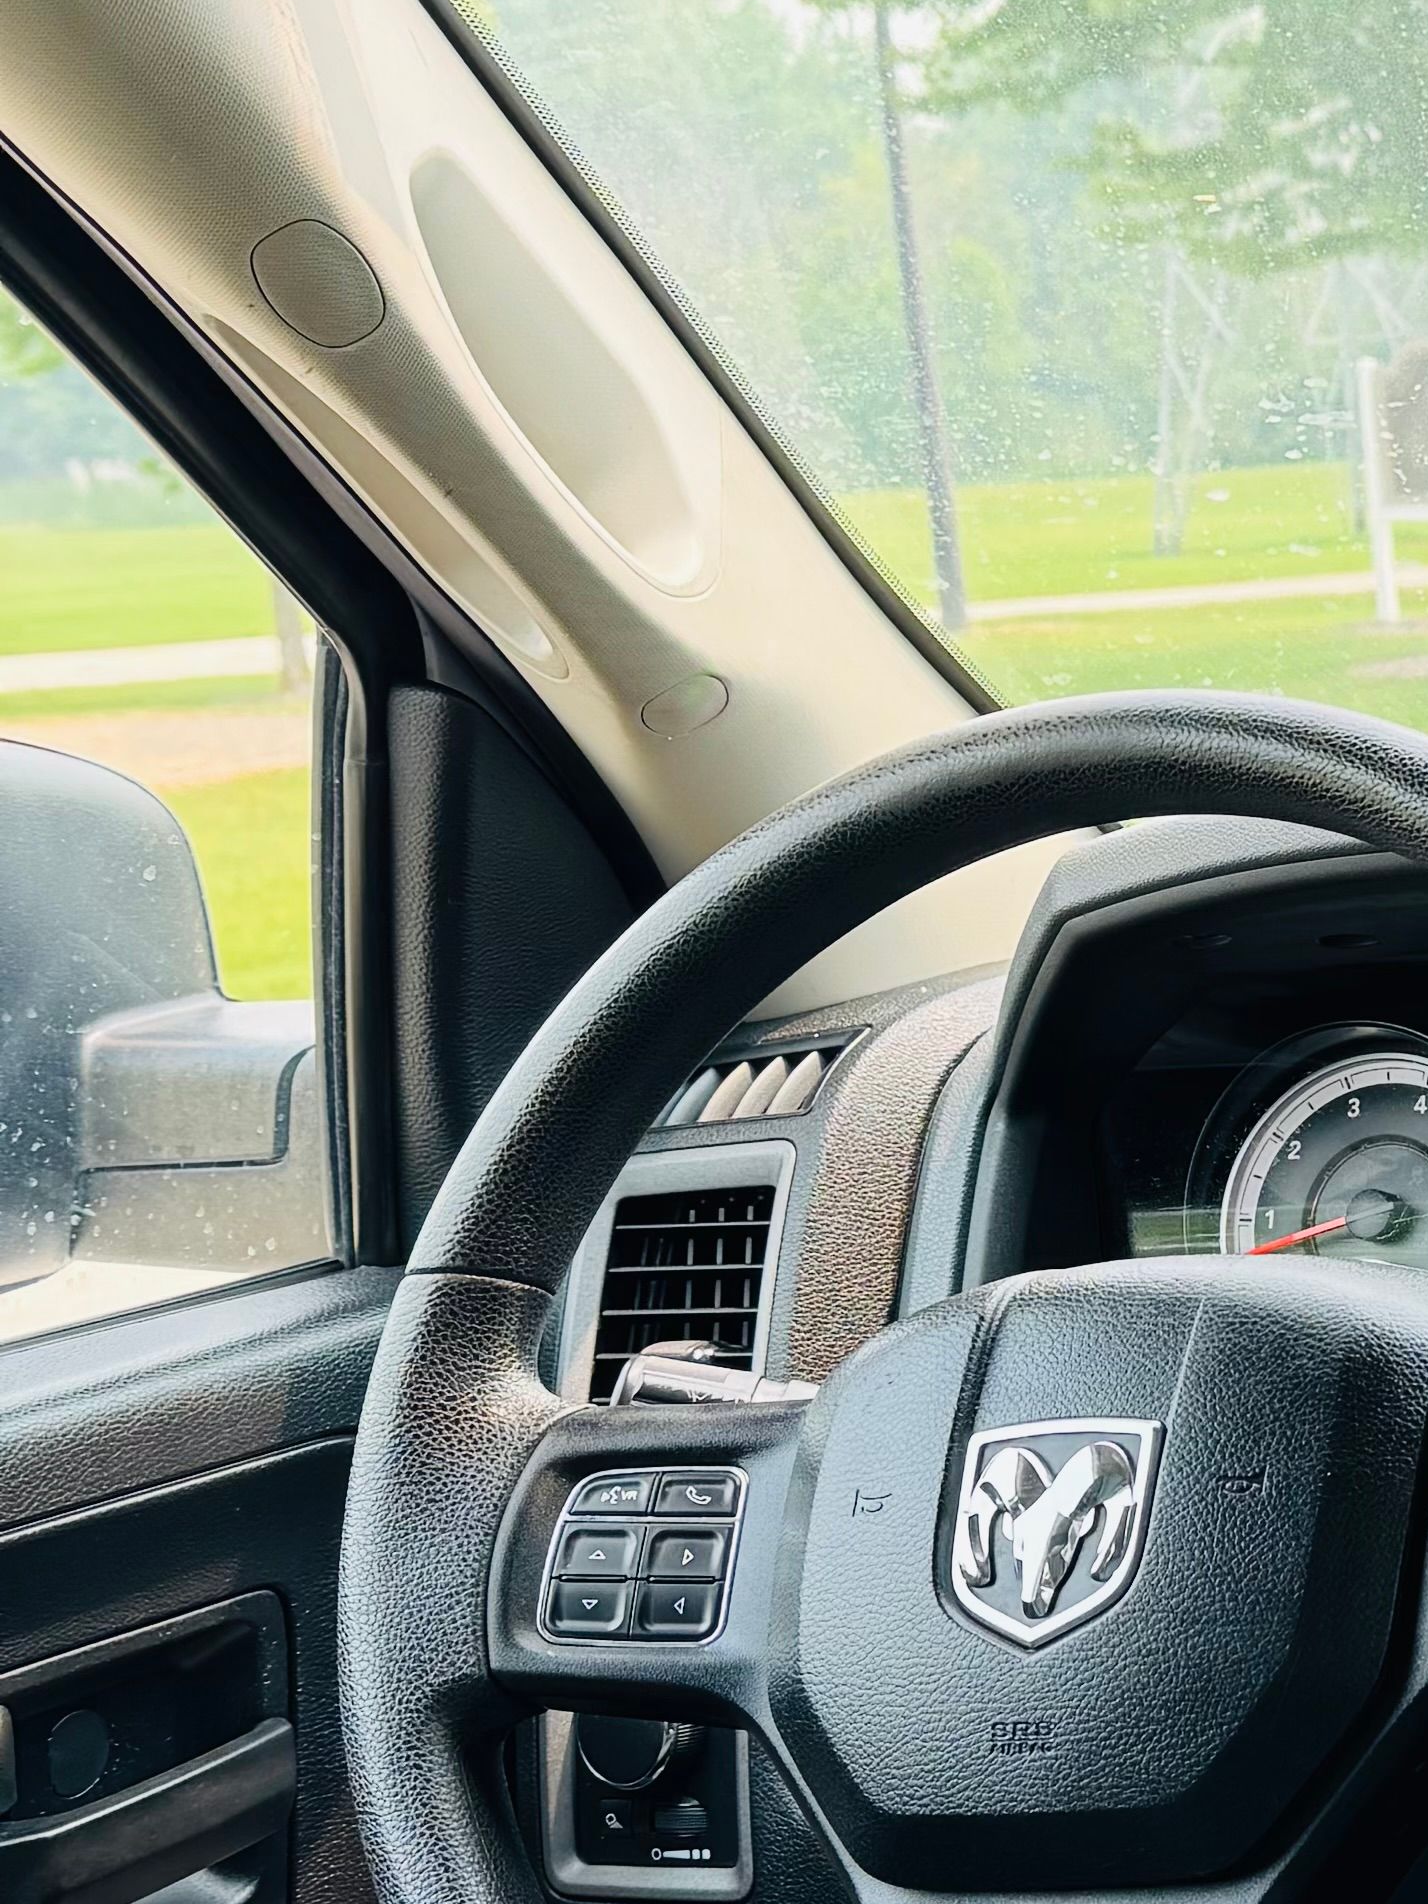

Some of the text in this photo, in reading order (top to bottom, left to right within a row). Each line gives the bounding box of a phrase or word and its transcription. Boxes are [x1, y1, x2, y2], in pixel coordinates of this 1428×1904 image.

[1346, 1098, 1360, 1118] 3
[1414, 1094, 1428, 1114] 4
[1288, 1141, 1301, 1160] 2
[1265, 1209, 1274, 1230] 1
